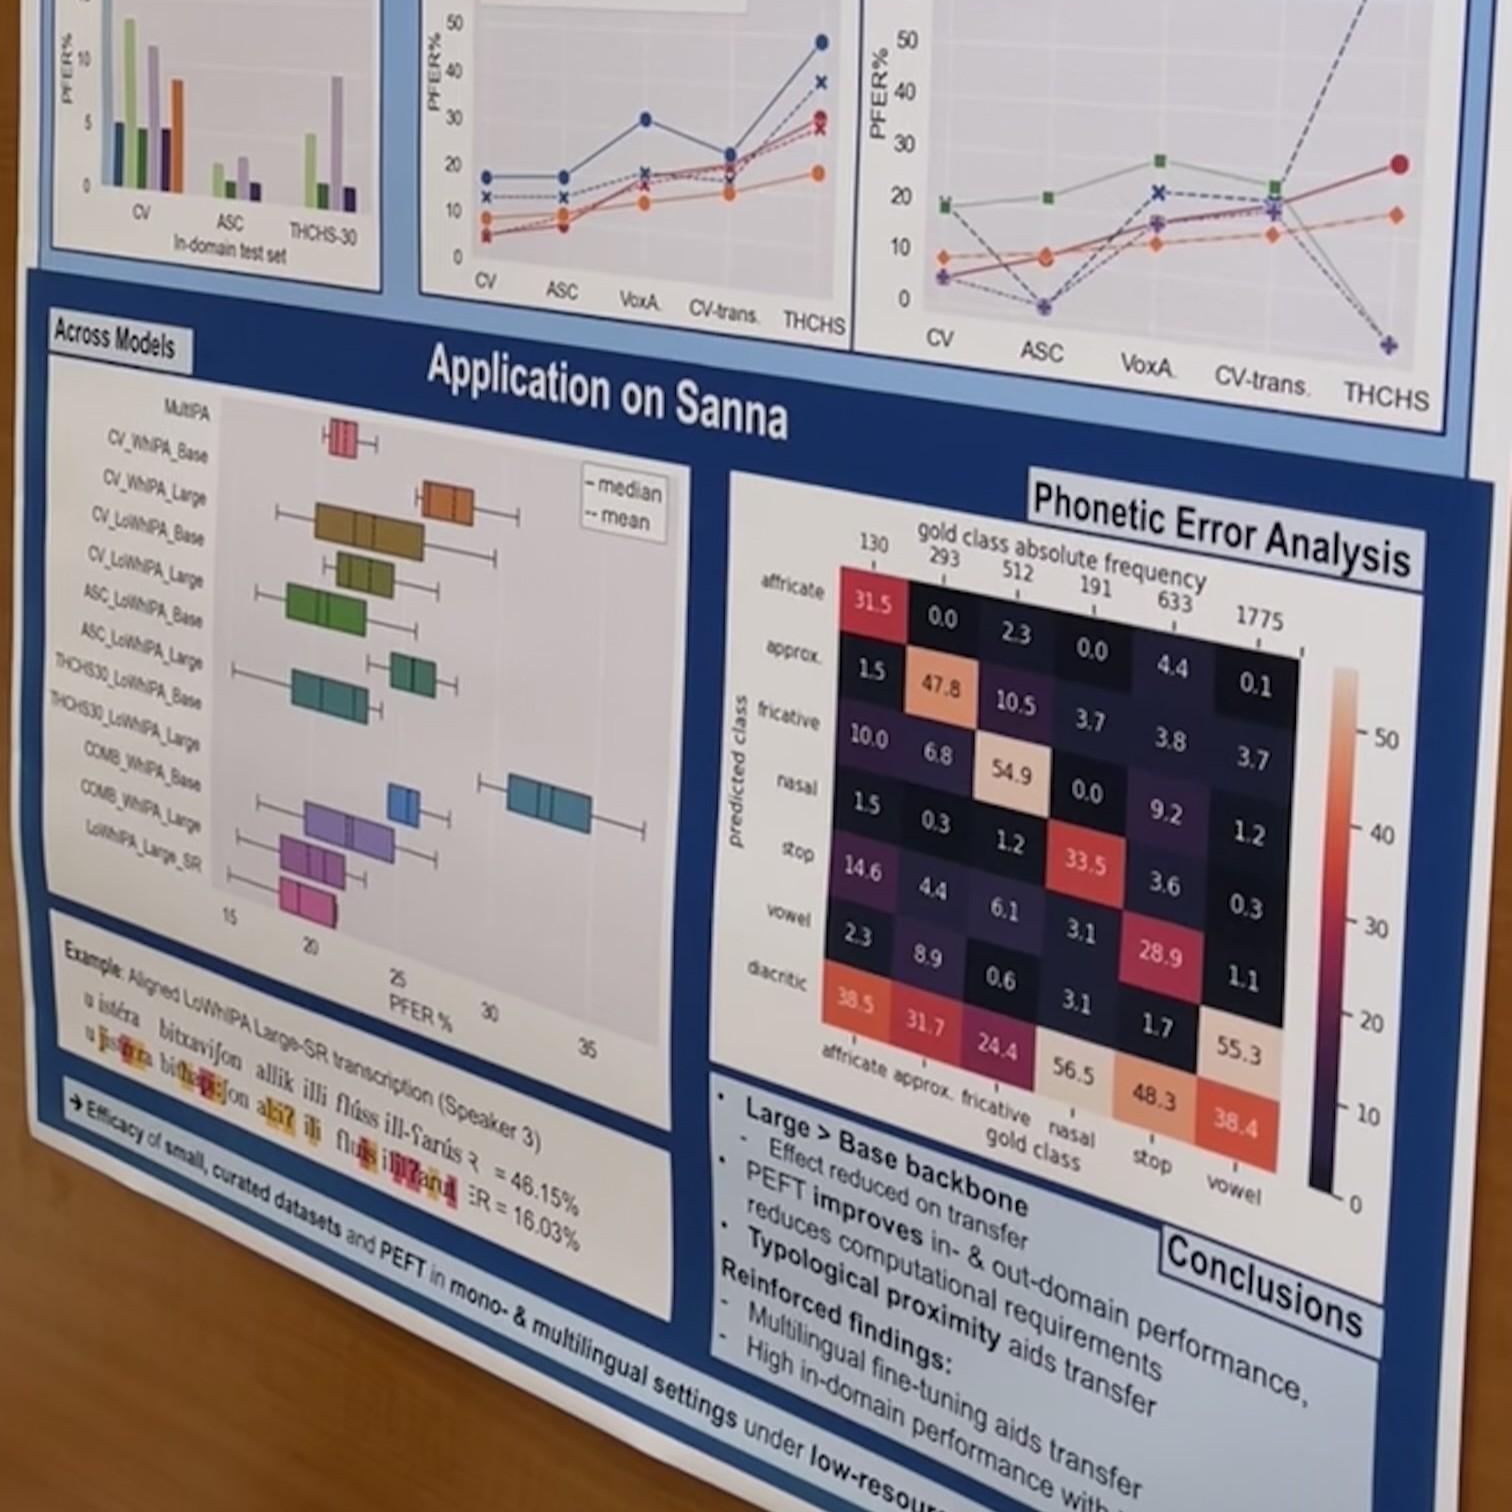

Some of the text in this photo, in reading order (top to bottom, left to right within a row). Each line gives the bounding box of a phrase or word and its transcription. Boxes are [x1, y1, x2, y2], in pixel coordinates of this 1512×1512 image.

[53, 315, 176, 360] Across Models
[426, 341, 788, 441] Application on Sanna
[1343, 380, 1431, 413] THCHS
[597, 477, 663, 504] median
[600, 508, 651, 532] mean
[1034, 480, 1411, 578] Phonetic Error Analysis
[916, 521, 1208, 597] gold class absolute frequency
[928, 544, 961, 568] 293
[1002, 558, 1035, 584] 512
[760, 572, 826, 601] affricate
[1236, 604, 1284, 632] 1775
[921, 672, 961, 699] 47.8
[757, 699, 821, 732] fricative
[1374, 726, 1400, 751] 50
[991, 757, 1033, 787] 54.9
[1064, 846, 1107, 877] 33.5
[1138, 938, 1183, 969] 28.9
[388, 992, 454, 1034] PFER %
[1216, 1034, 1262, 1067] 55.3
[746, 1095, 1029, 1218] Large > Base backbone
[86, 1099, 145, 1145] Efficacy
[147, 1132, 162, 1148] of
[164, 1140, 209, 1176] small,
[212, 1163, 271, 1203] curated
[274, 1191, 343, 1238] datasets
[345, 1228, 376, 1255] and
[379, 1239, 428, 1279] PEFT
[429, 1269, 446, 1289] in
[449, 1278, 509, 1316] mono-
[512, 1304, 527, 1329] &
[531, 1318, 650, 1387] multilingual
[652, 1375, 738, 1429] settings
[743, 1418, 805, 1459] under
[746, 1159, 1308, 1409] PEFT improves in- & out-domain performance,
[1167, 1233, 1363, 1339] Conclusions
[721, 1255, 952, 1375] Reinforced findings:
[747, 1224, 1158, 1418] Typological proximity aids transfer
